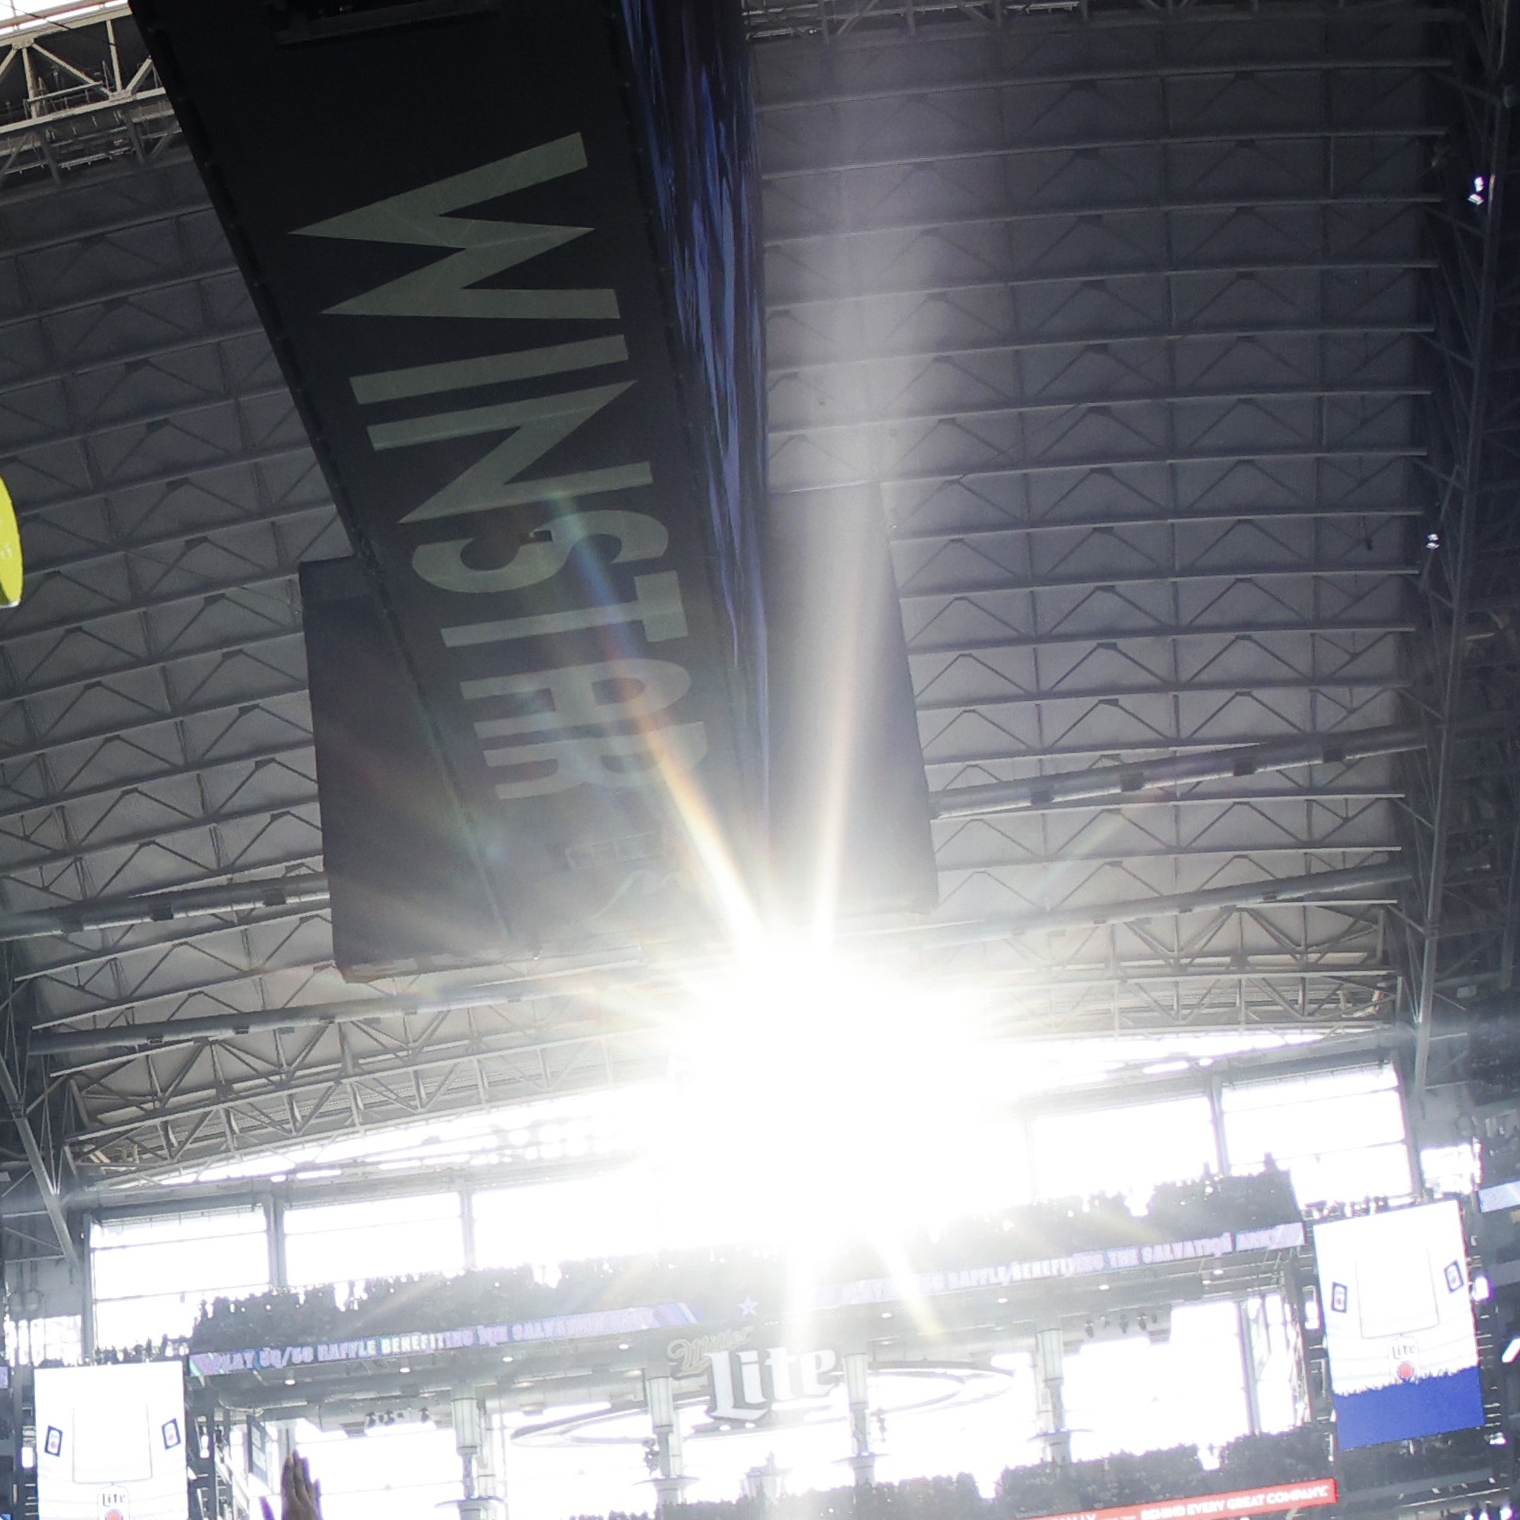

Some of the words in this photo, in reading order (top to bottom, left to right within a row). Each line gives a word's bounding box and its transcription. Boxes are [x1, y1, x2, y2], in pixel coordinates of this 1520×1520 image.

[288, 131, 708, 801] WINSTAR
[667, 1325, 756, 1377] Miller
[703, 1346, 836, 1420] Lite
[1186, 1500, 1226, 1516] EVERY
[1226, 1493, 1265, 1510] GREAT
